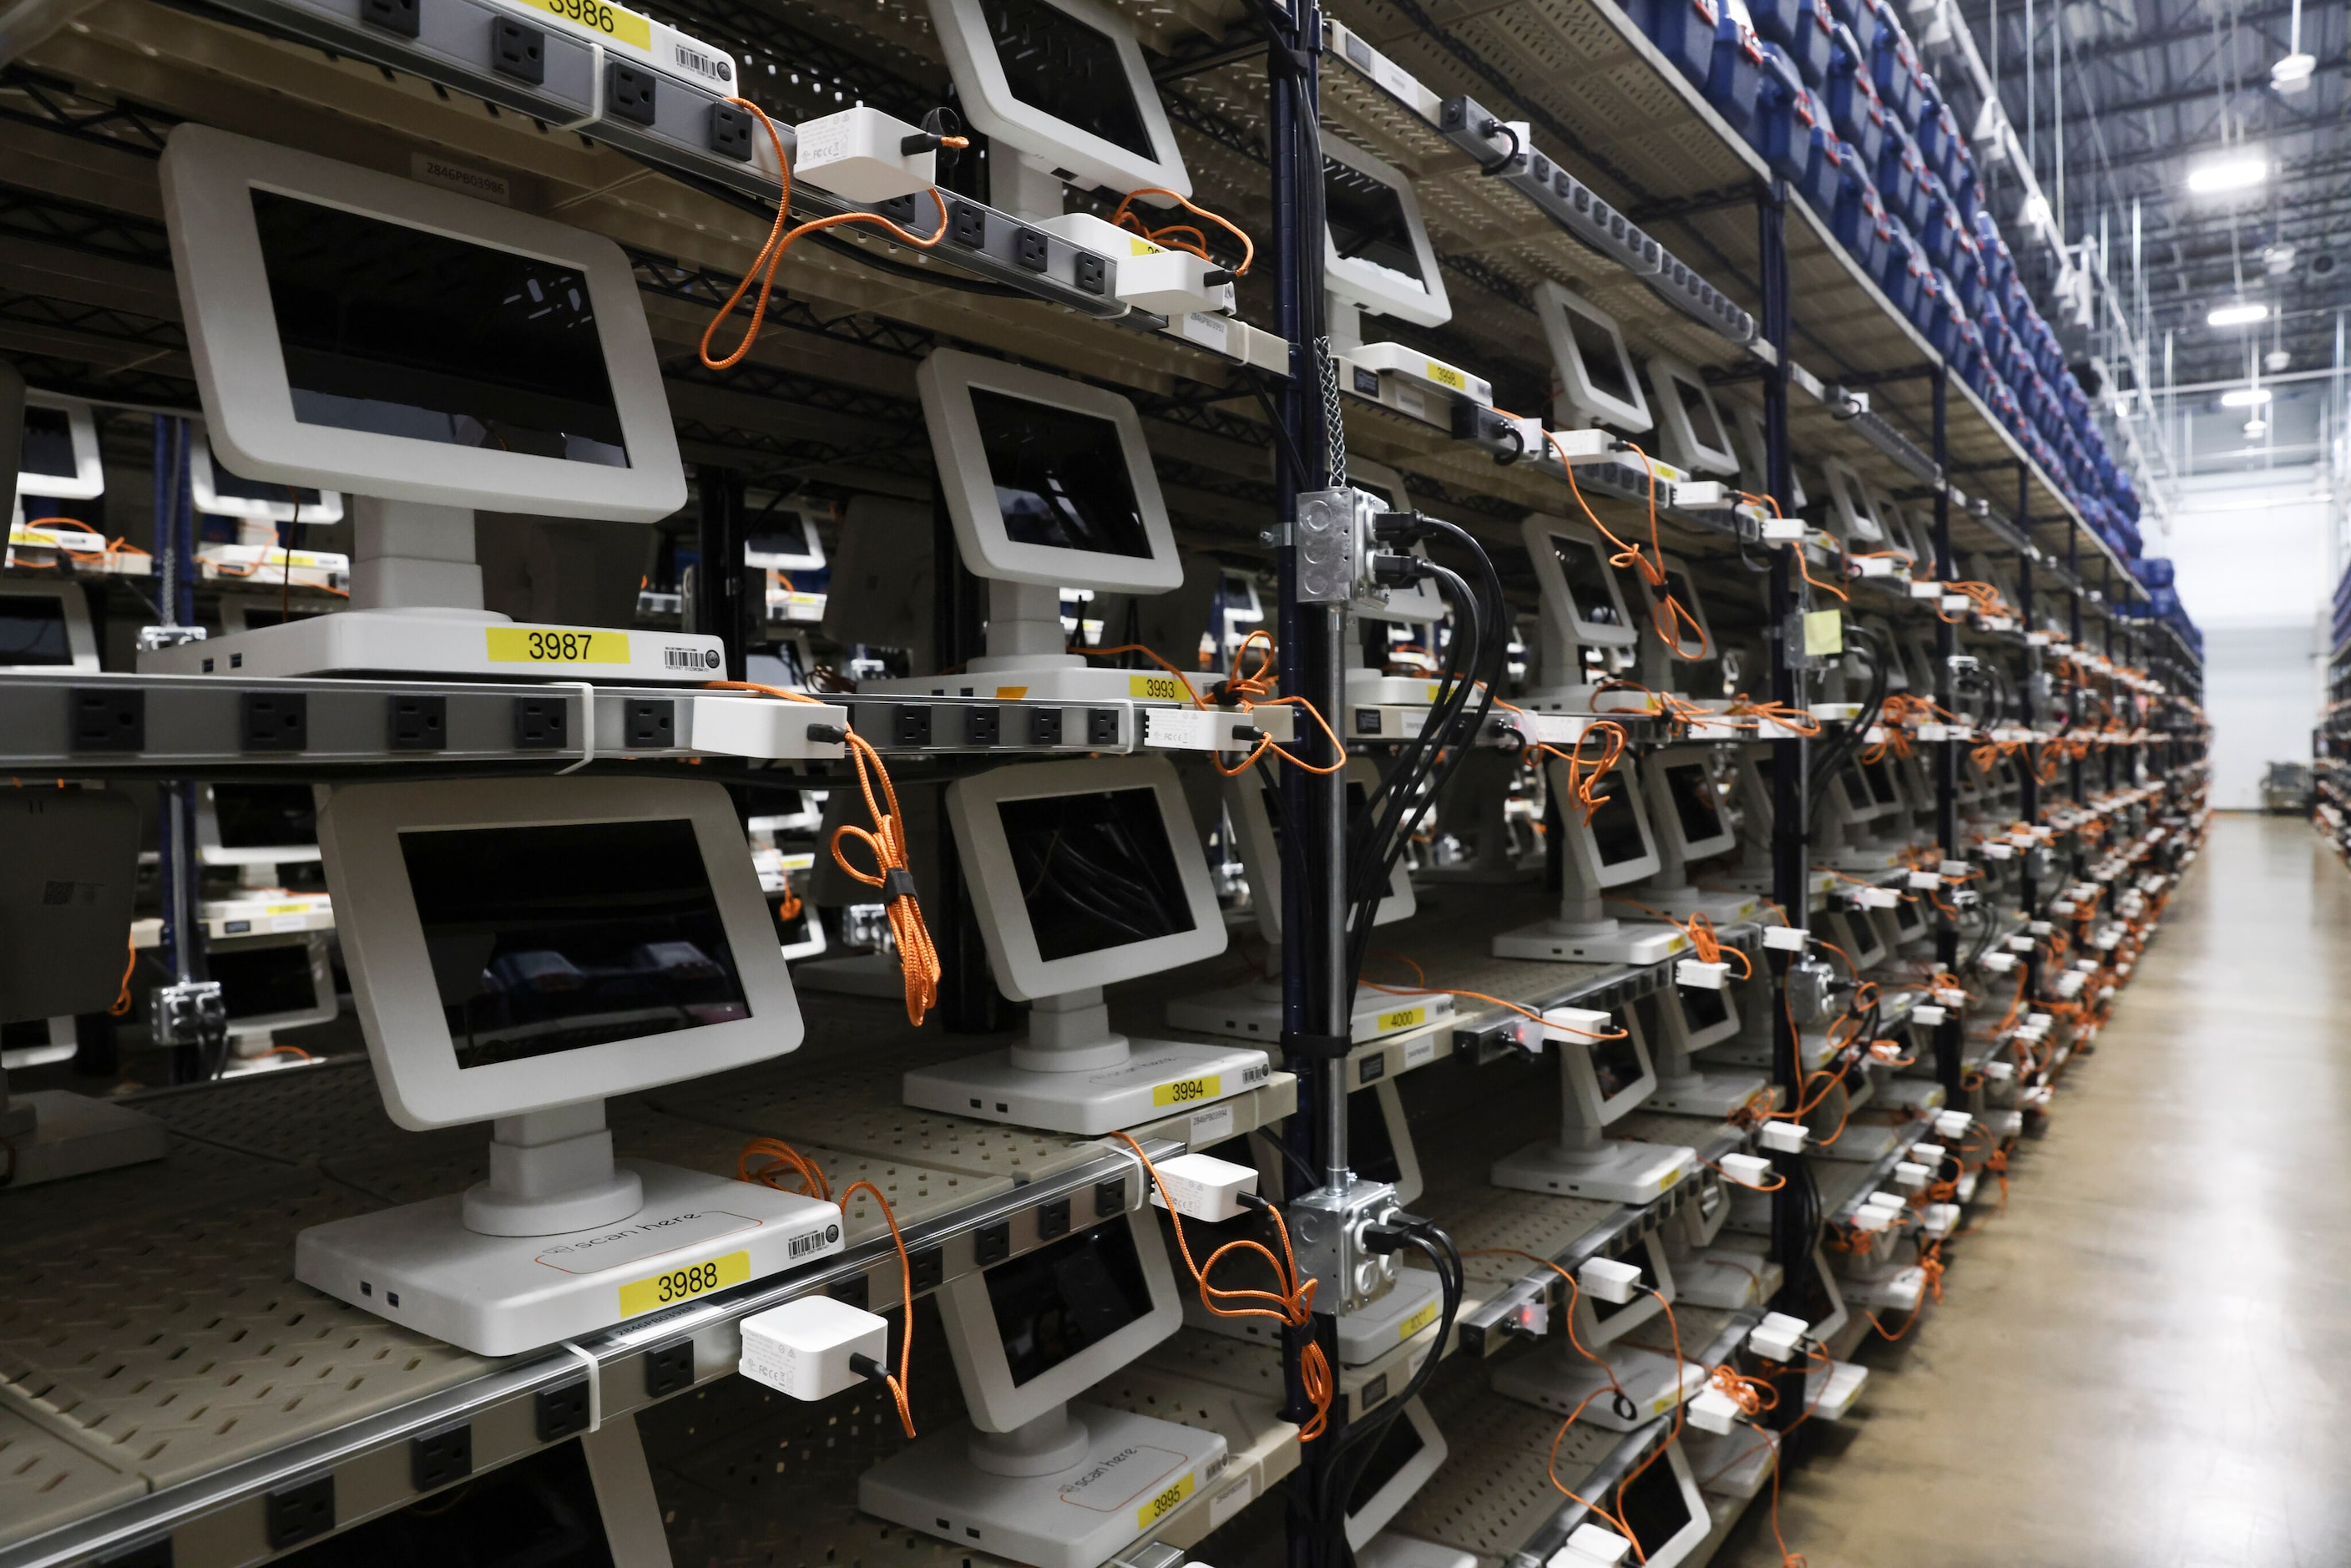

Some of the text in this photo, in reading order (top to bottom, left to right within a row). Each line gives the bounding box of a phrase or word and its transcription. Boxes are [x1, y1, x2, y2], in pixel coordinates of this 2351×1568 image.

[1437, 367, 1456, 386] 3998
[528, 632, 592, 660] 3987
[1146, 679, 1175, 699] 3993
[1391, 1010, 1414, 1028] 4000
[1172, 1080, 1204, 1102] 3994
[574, 1213, 701, 1249] scan here
[658, 1262, 718, 1302] 3988
[1074, 1448, 1137, 1487] scan here
[1154, 1485, 1181, 1519] 3995
